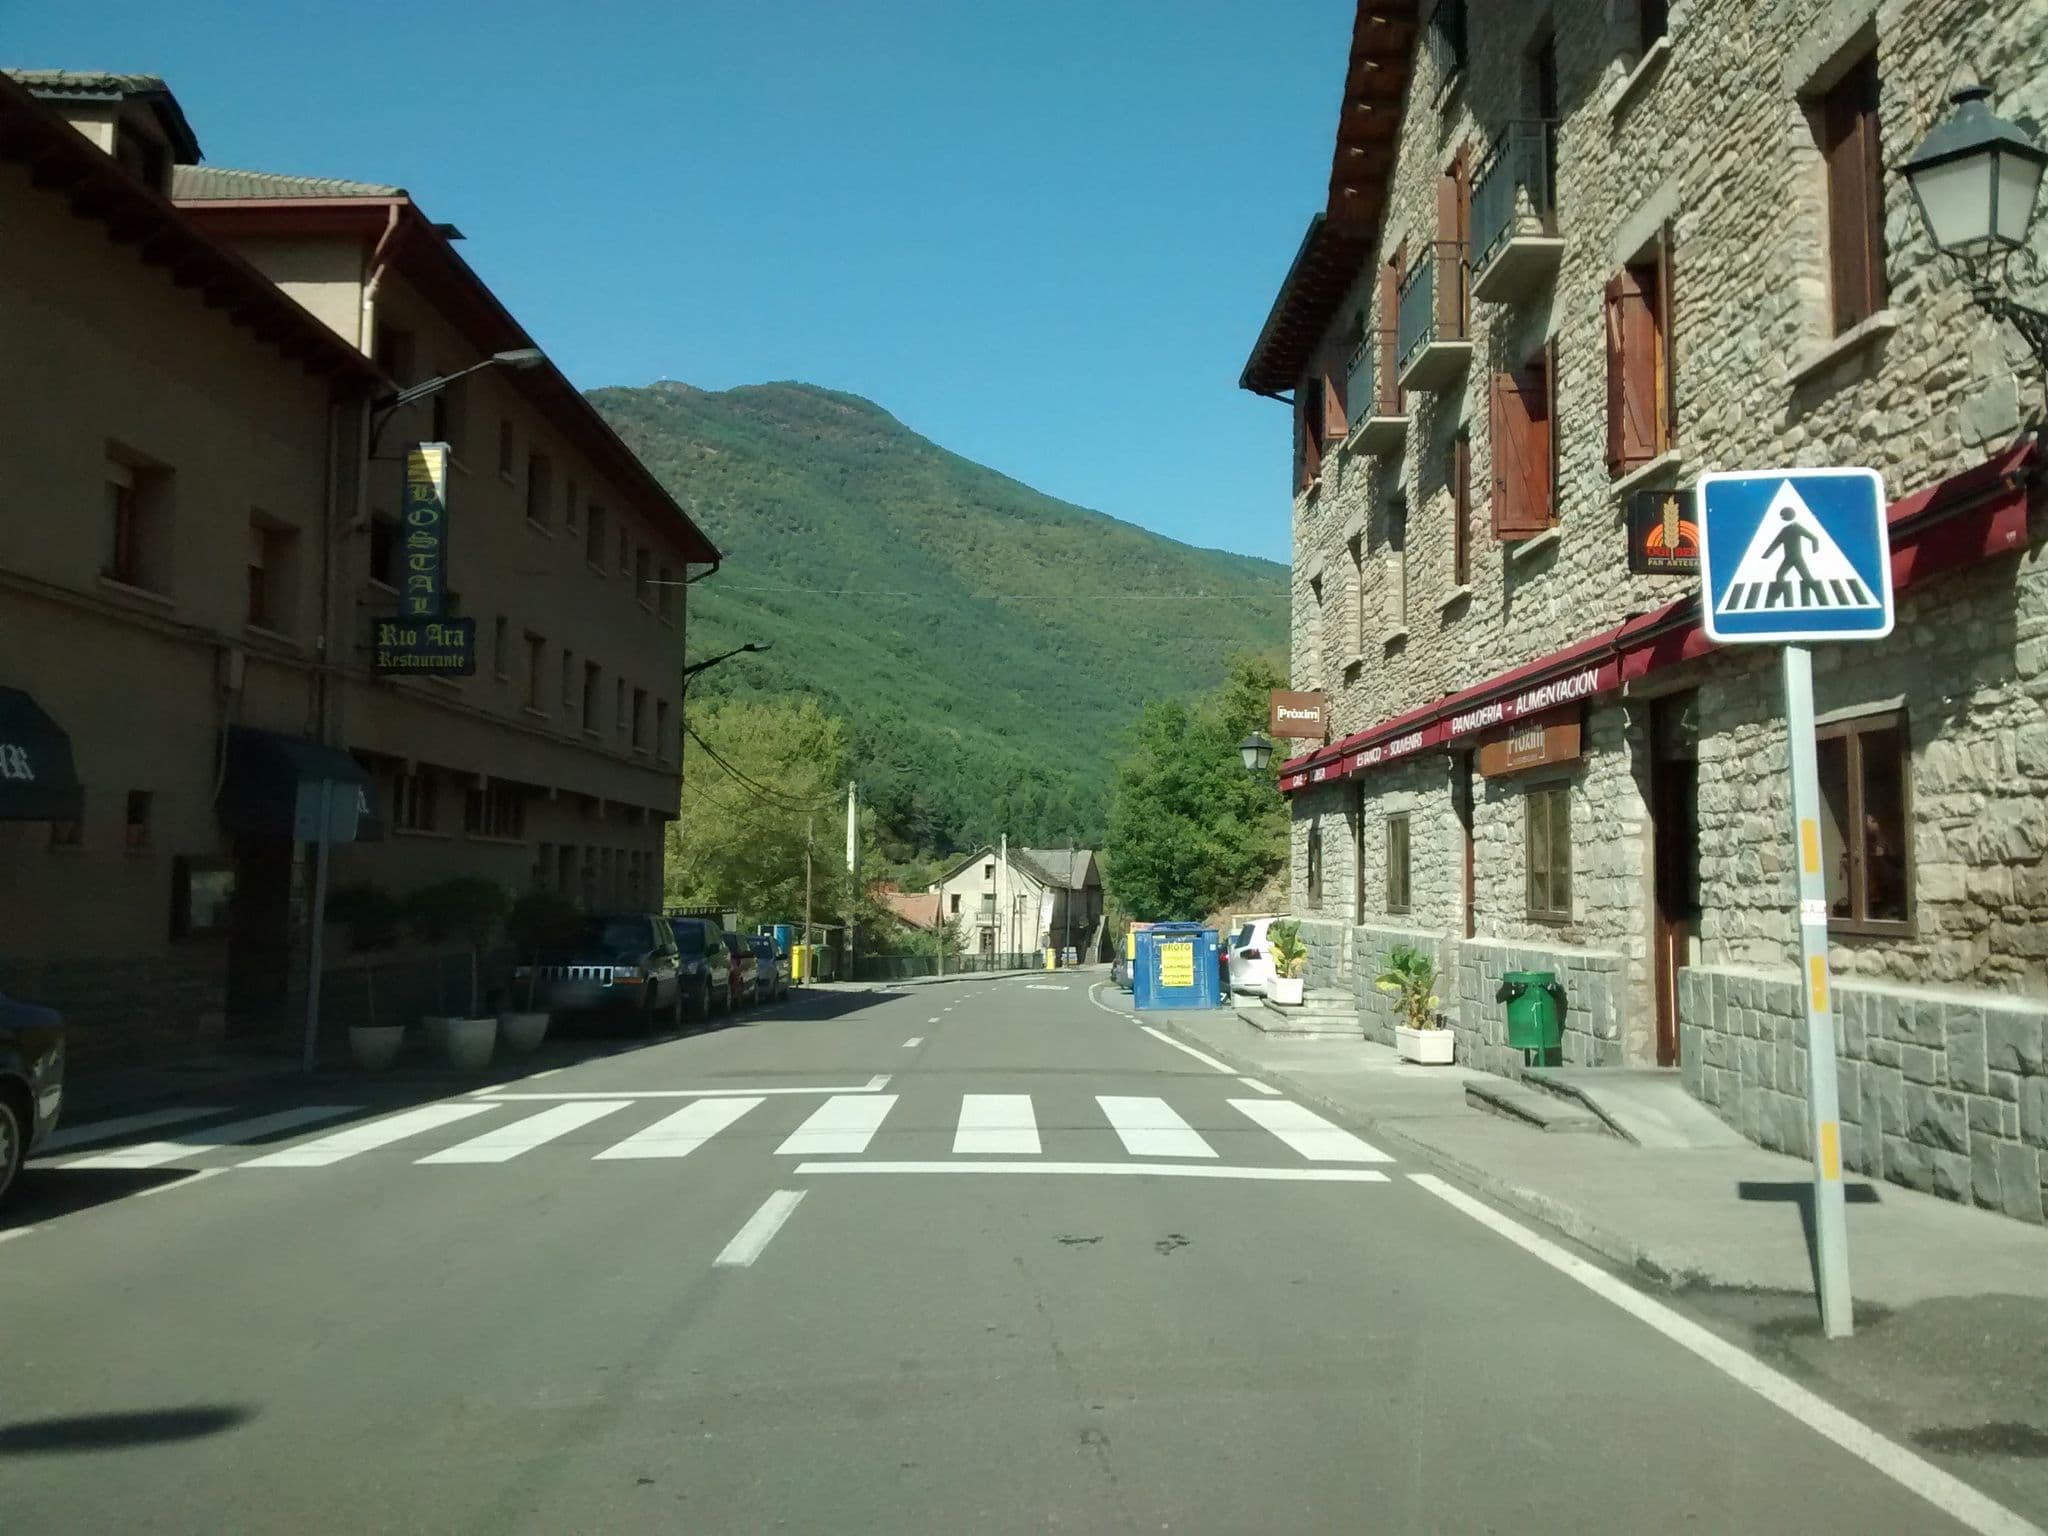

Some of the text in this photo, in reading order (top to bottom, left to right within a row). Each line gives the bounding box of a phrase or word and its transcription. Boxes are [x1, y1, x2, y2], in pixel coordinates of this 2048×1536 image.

[408, 484, 439, 615] HOSTAL
[425, 623, 465, 647] Ara
[377, 651, 465, 668] Restaurante
[1451, 700, 1504, 734] PANADERÍA
[1516, 667, 1599, 714] ALIMENTACIÓN
